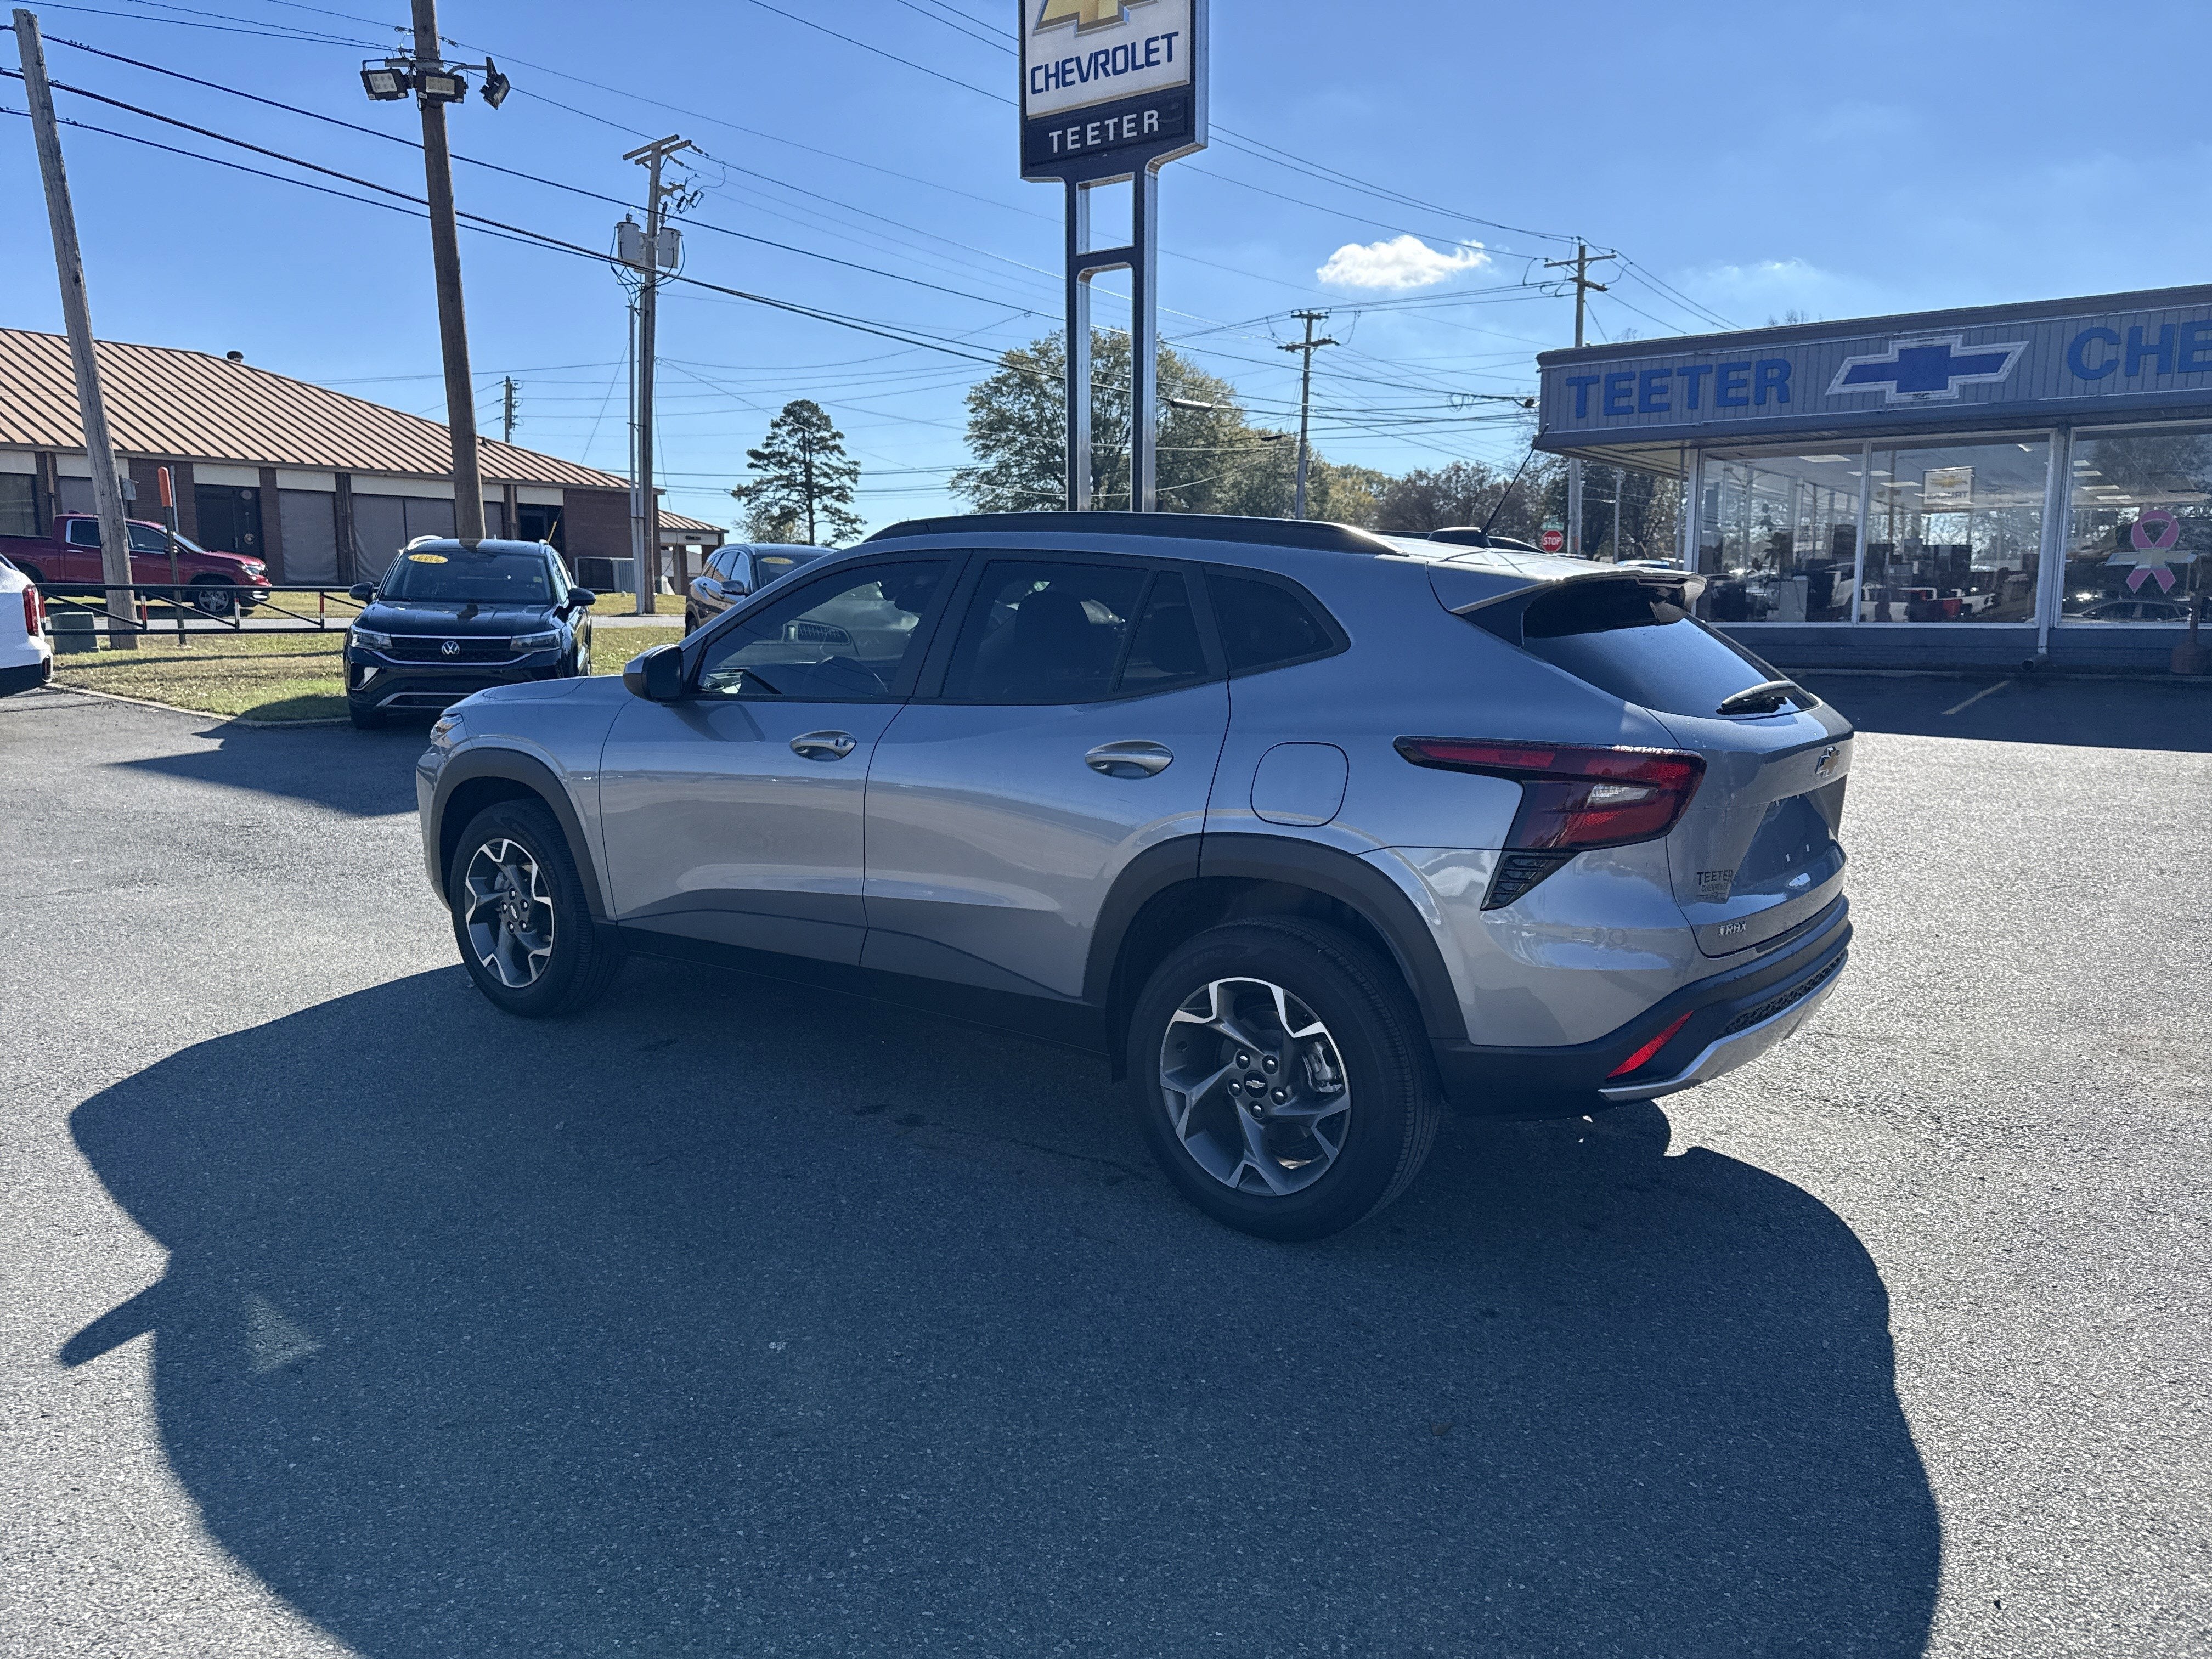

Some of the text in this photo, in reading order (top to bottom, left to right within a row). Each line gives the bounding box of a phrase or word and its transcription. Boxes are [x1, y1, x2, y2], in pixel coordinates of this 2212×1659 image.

[1030, 31, 1179, 94] CHEVROLET
[1049, 110, 1159, 153] TEETER
[1566, 358, 1792, 419] TEETER
[1542, 536, 1562, 546] STOP
[1696, 869, 1733, 885] TEETER
[1701, 882, 1729, 892] CHEVROLET
[1718, 921, 1747, 936] TRAX
